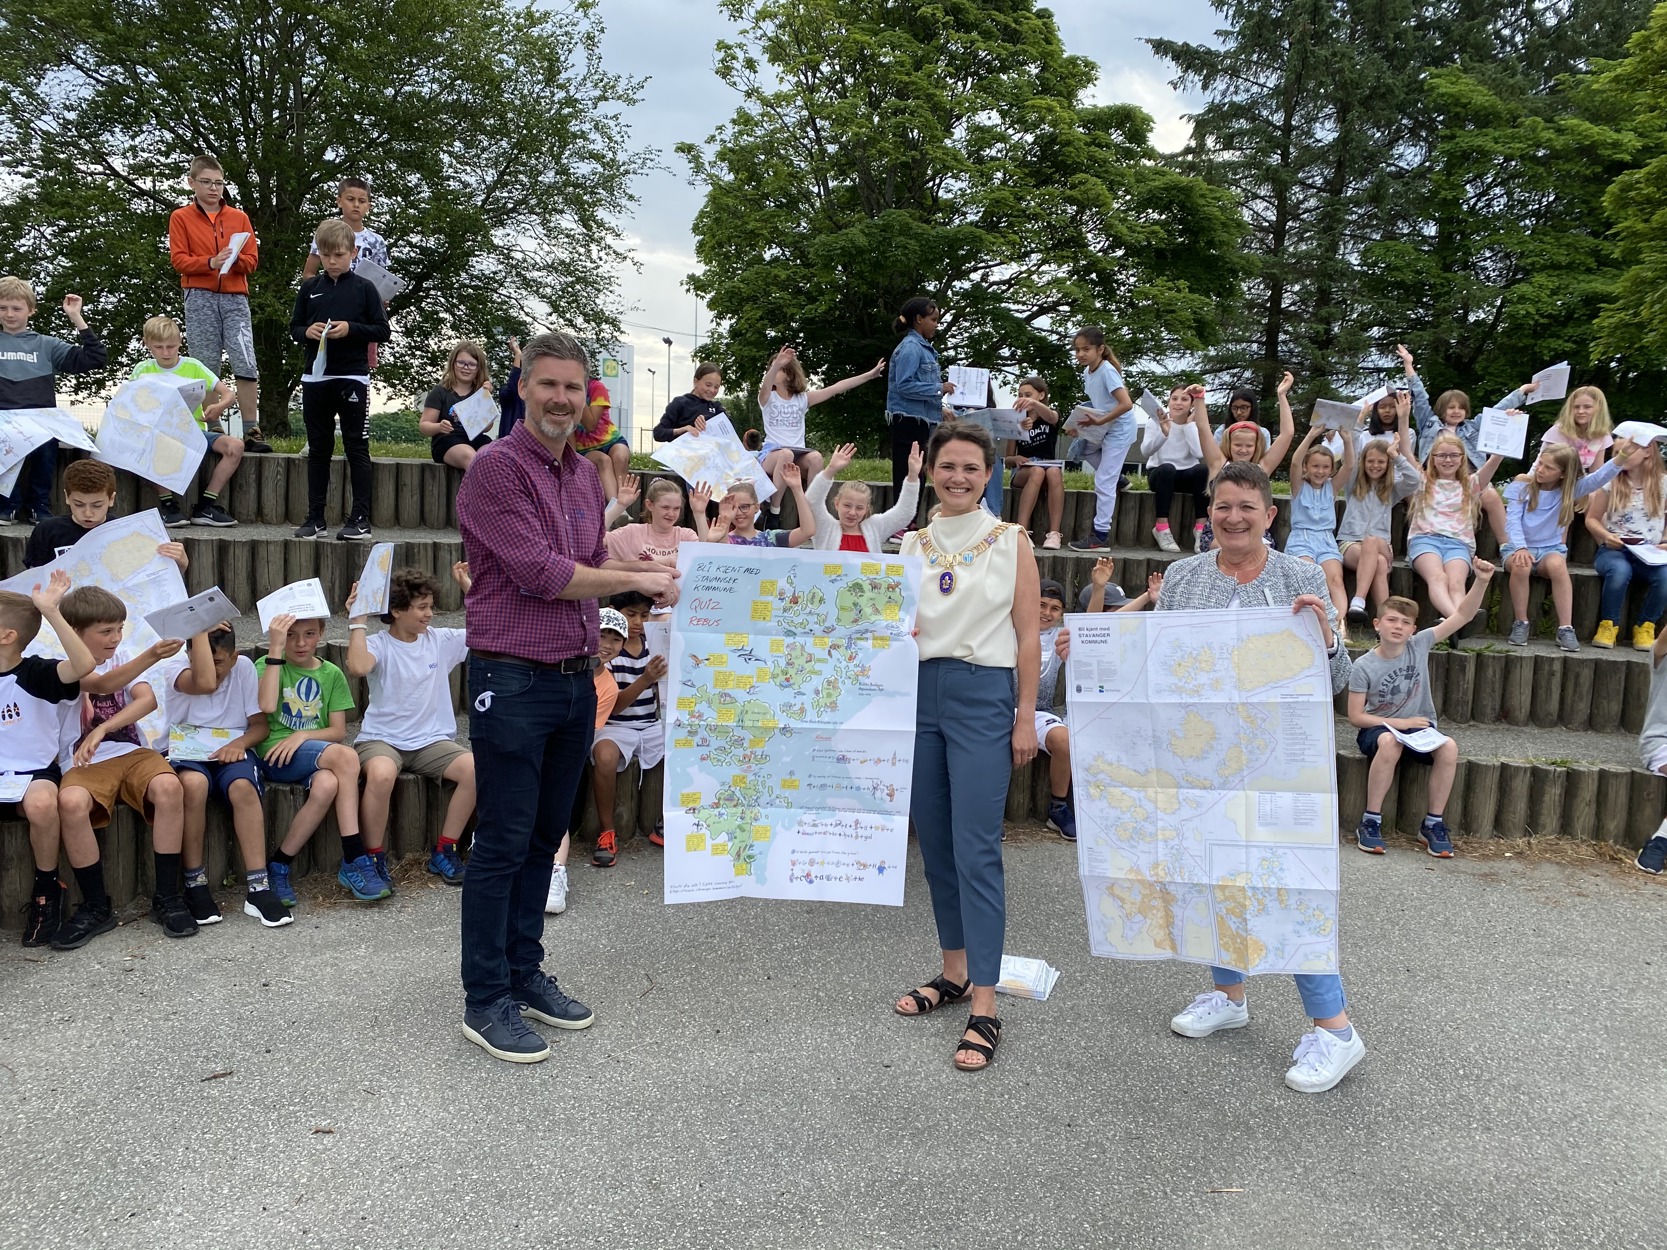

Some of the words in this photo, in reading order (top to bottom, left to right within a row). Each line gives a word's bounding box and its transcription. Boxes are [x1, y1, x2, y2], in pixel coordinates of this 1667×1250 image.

[645, 546, 679, 557] HOLIDAYS
[696, 561, 713, 573] BLI
[715, 564, 743, 575] KJENT
[743, 566, 761, 576] MED
[693, 574, 739, 585] STAVANGER
[693, 583, 737, 594] KOMMUNE
[689, 597, 723, 614] QUIZ
[688, 615, 722, 627] REBUS
